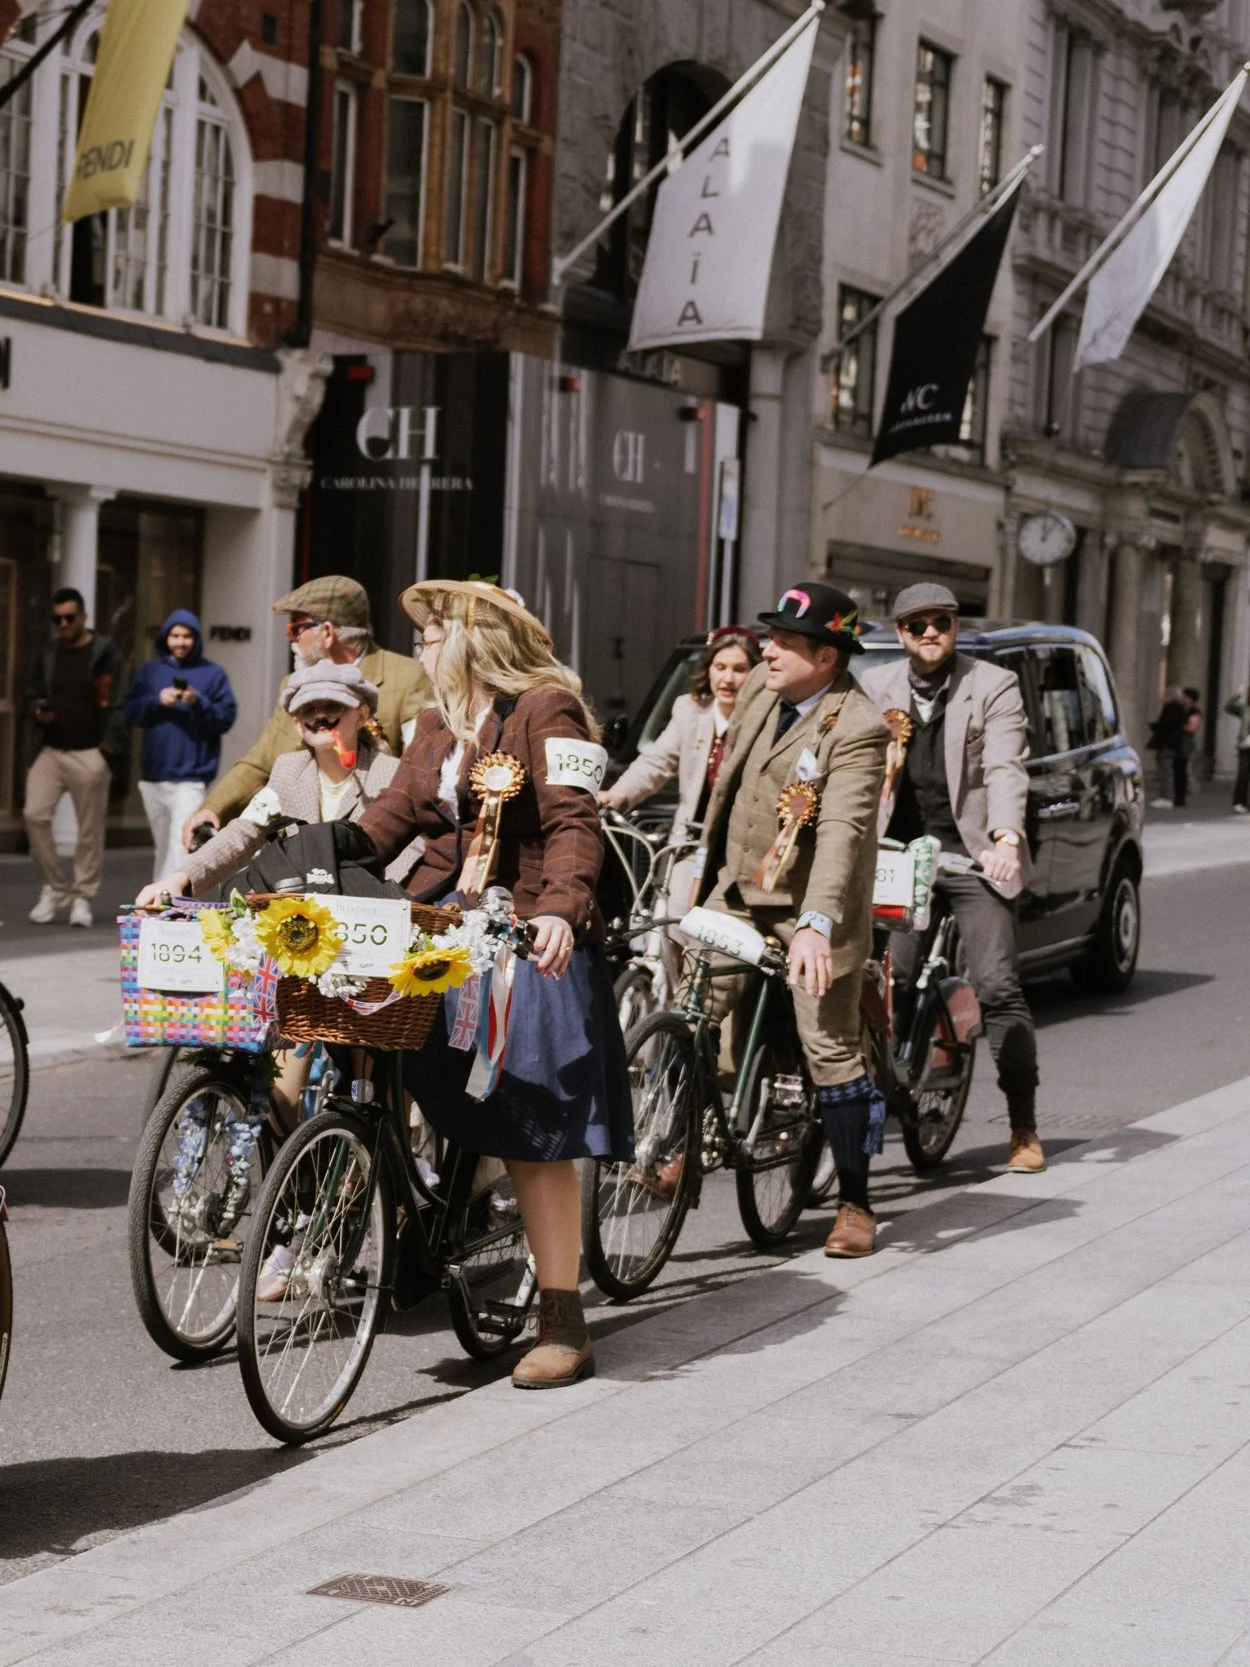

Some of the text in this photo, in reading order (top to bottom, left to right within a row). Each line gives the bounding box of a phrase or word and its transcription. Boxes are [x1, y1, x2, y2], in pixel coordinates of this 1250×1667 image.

[356, 405, 442, 460] CH
[321, 475, 473, 491] CAROLINA HERERA
[555, 753, 603, 785] 1850
[334, 921, 388, 946] 850
[151, 943, 202, 963] 1894
